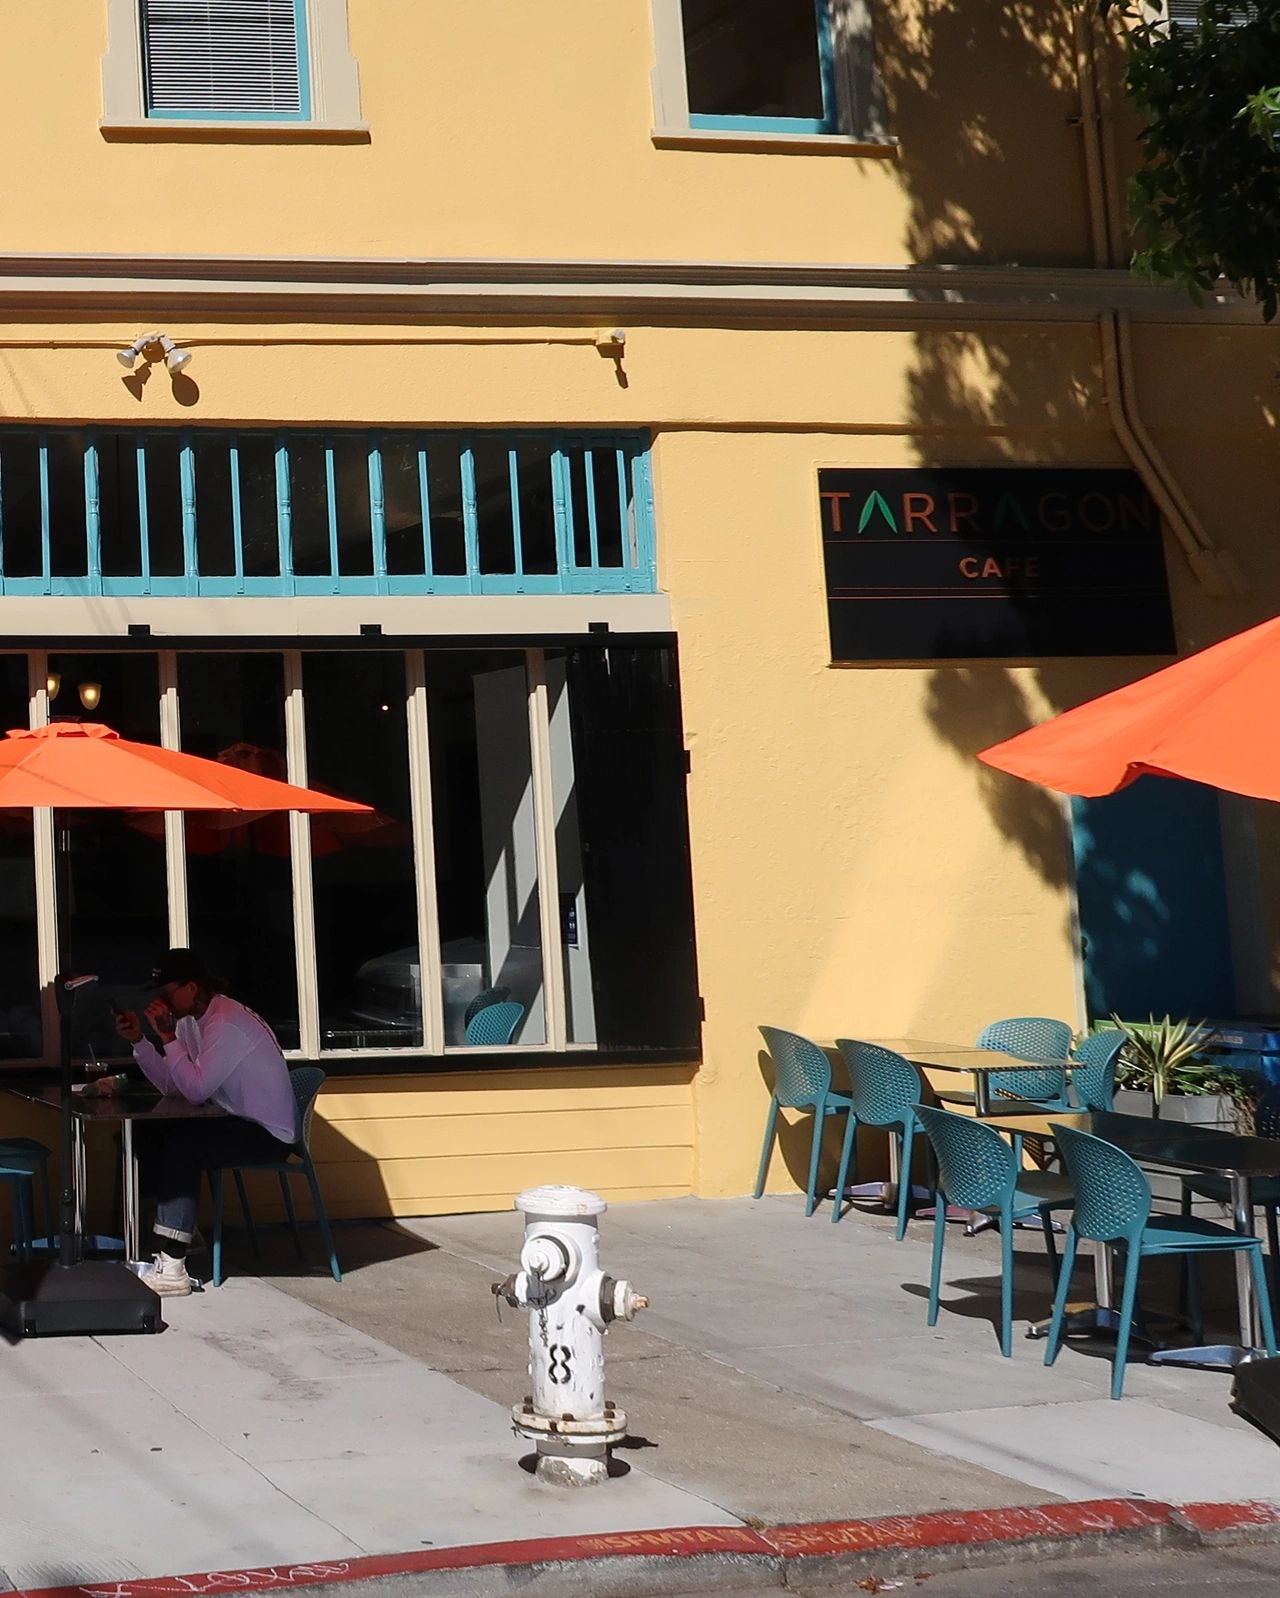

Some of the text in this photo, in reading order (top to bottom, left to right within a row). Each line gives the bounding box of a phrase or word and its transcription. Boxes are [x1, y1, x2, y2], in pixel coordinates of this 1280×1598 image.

[820, 490, 1152, 534] TARRAGON
[958, 556, 1041, 578] CAFE
[605, 1529, 725, 1549] SFMTA
